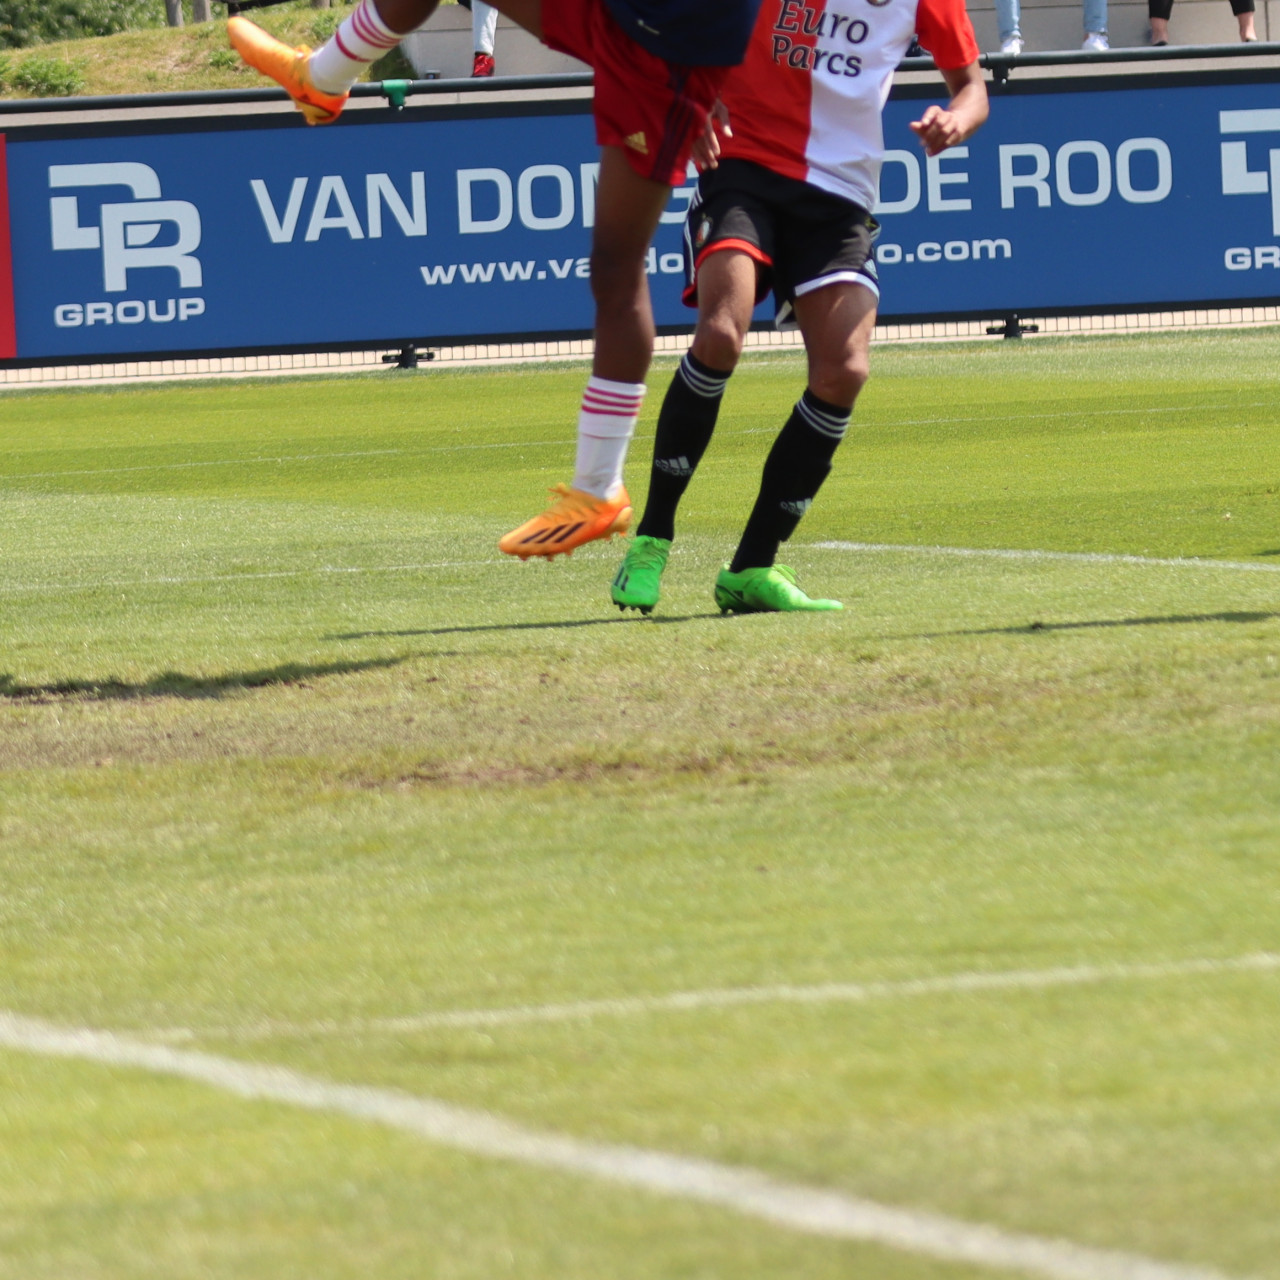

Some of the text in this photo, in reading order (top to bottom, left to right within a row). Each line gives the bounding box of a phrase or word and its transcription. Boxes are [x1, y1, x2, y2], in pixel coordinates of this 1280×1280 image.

[772, 34, 862, 78] Parcs
[250, 170, 428, 244] VAN
[870, 146, 972, 215] DE
[998, 137, 1173, 210] ROO
[54, 297, 206, 328] GROUP
